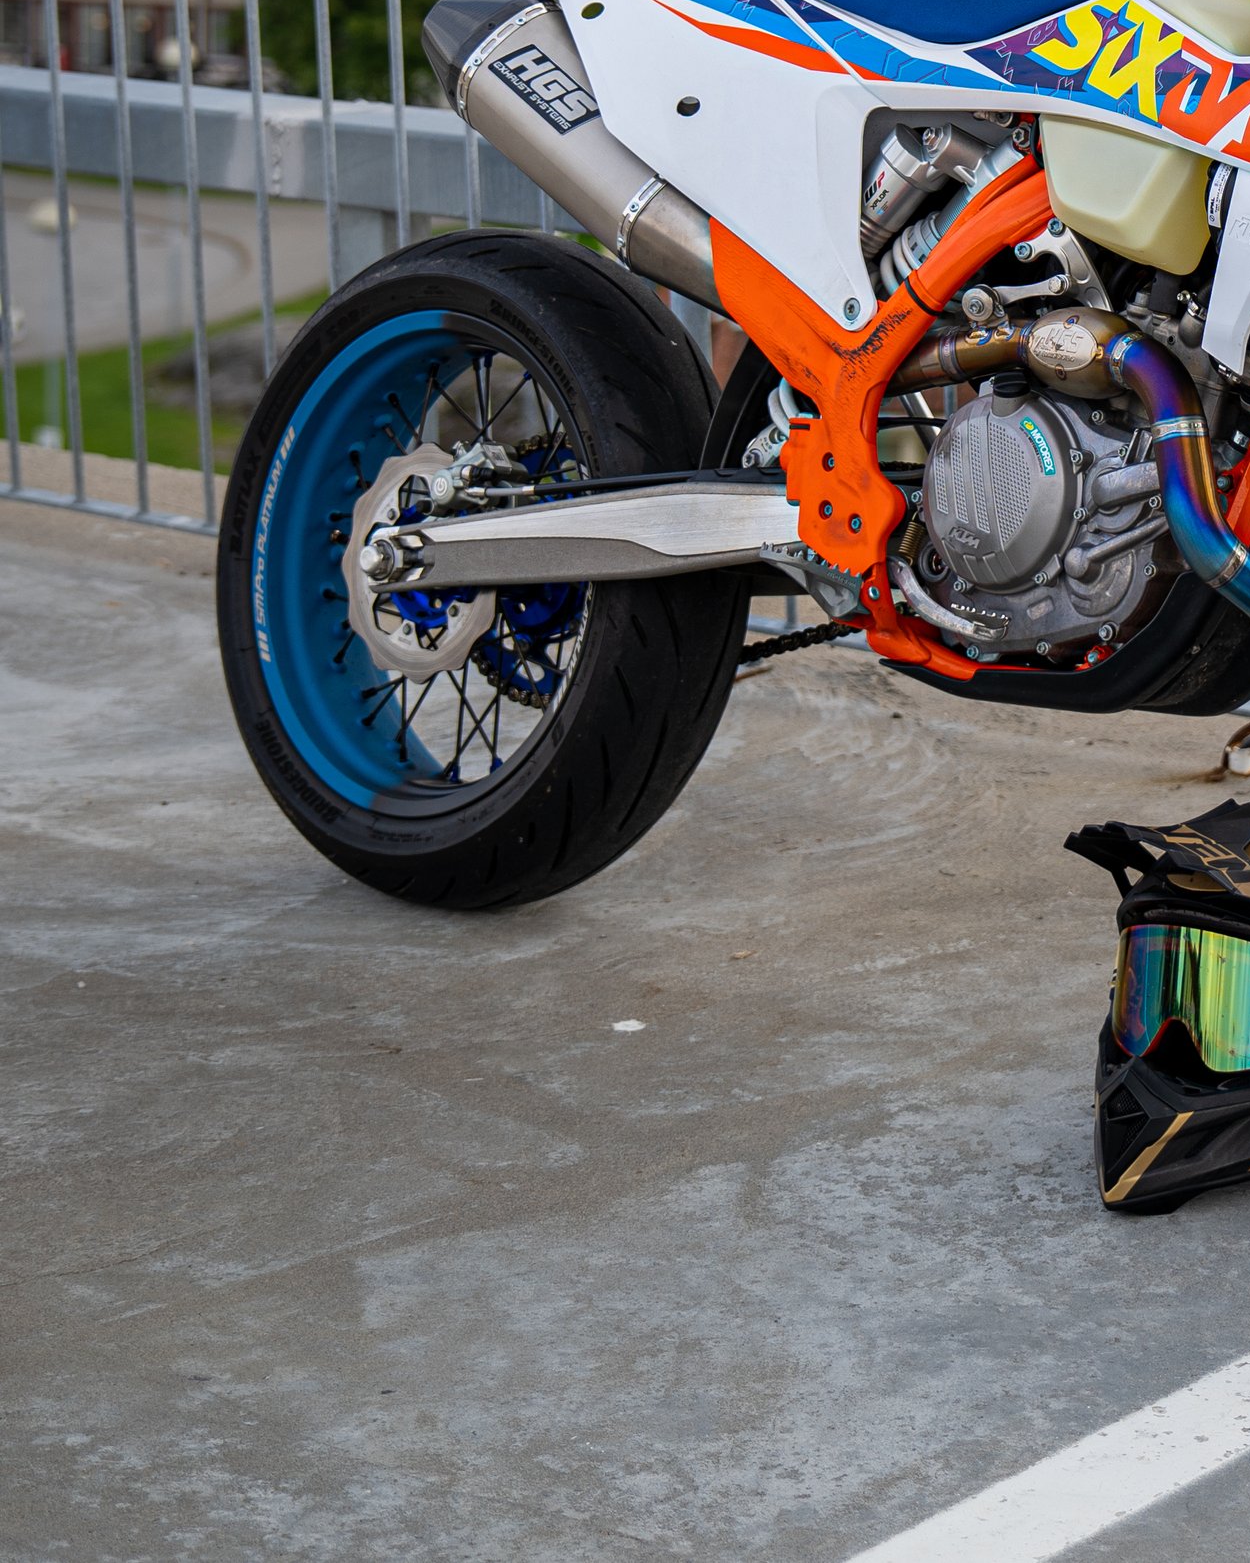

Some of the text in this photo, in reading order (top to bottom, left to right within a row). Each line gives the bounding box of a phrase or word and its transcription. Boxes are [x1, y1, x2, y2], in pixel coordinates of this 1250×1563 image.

[493, 61, 572, 131] EXHAUST SYSTEMS
[504, 48, 599, 122] HGS
[1029, 427, 1054, 472] MOTOREX
[256, 459, 283, 554] PLATINUM
[949, 526, 980, 549] KTM
